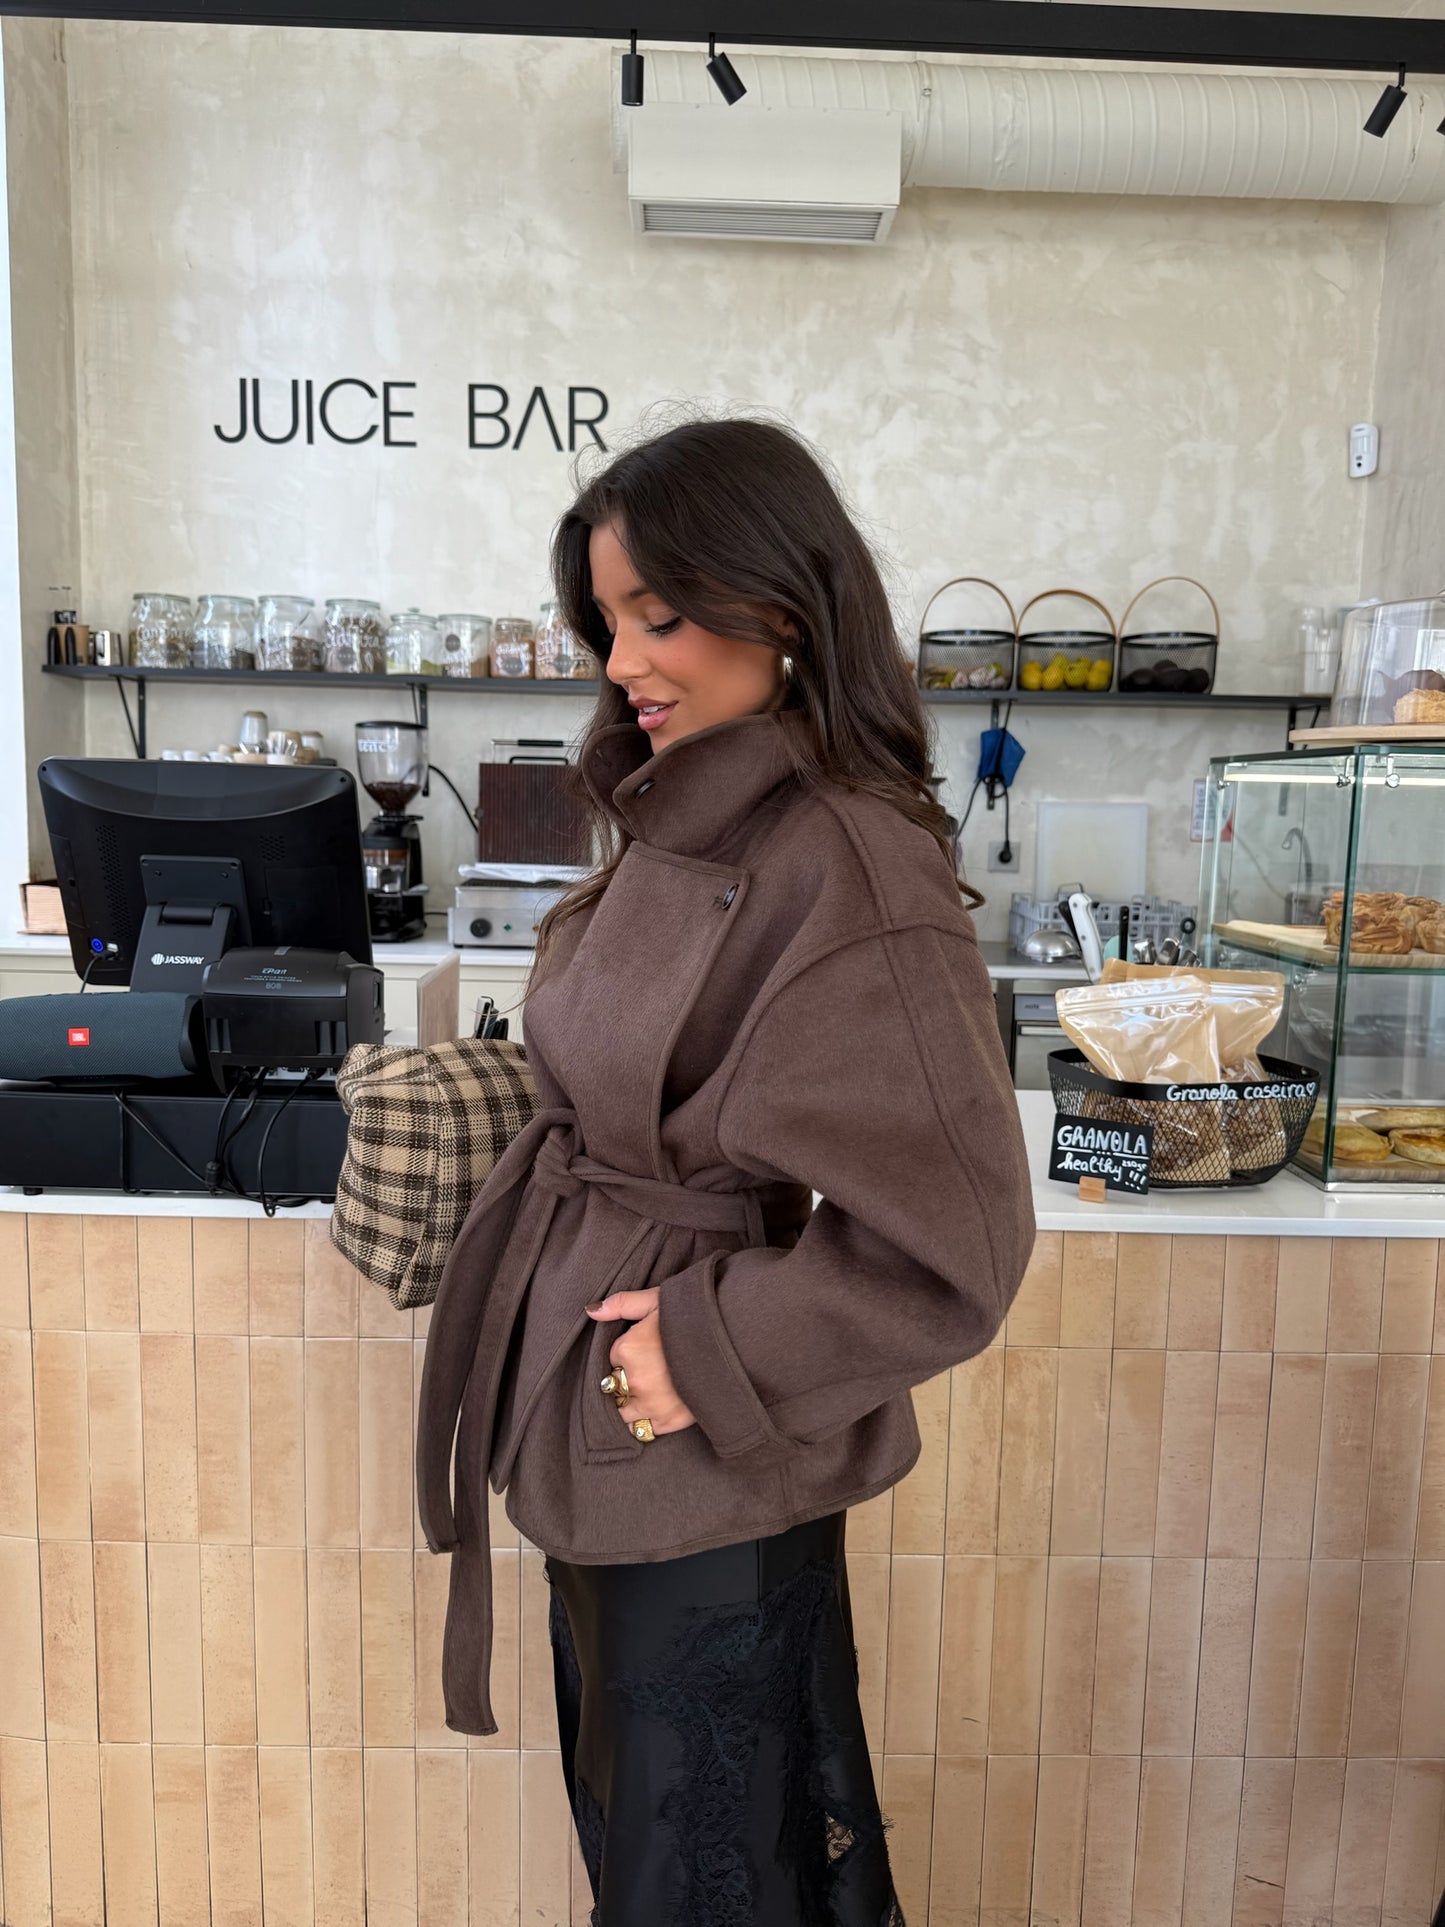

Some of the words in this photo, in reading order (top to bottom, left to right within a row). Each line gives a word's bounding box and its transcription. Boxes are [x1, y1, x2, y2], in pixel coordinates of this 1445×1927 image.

[213, 378, 417, 448] JUICE
[467, 383, 609, 452] BAR
[164, 954, 205, 965] JASSWAY
[72, 1032, 87, 1042] JBL
[1166, 1084, 1239, 1101] Granola
[1243, 1081, 1306, 1100] caseira
[1057, 1124, 1147, 1155] GRANOLA
[1057, 1151, 1122, 1182] healthy
